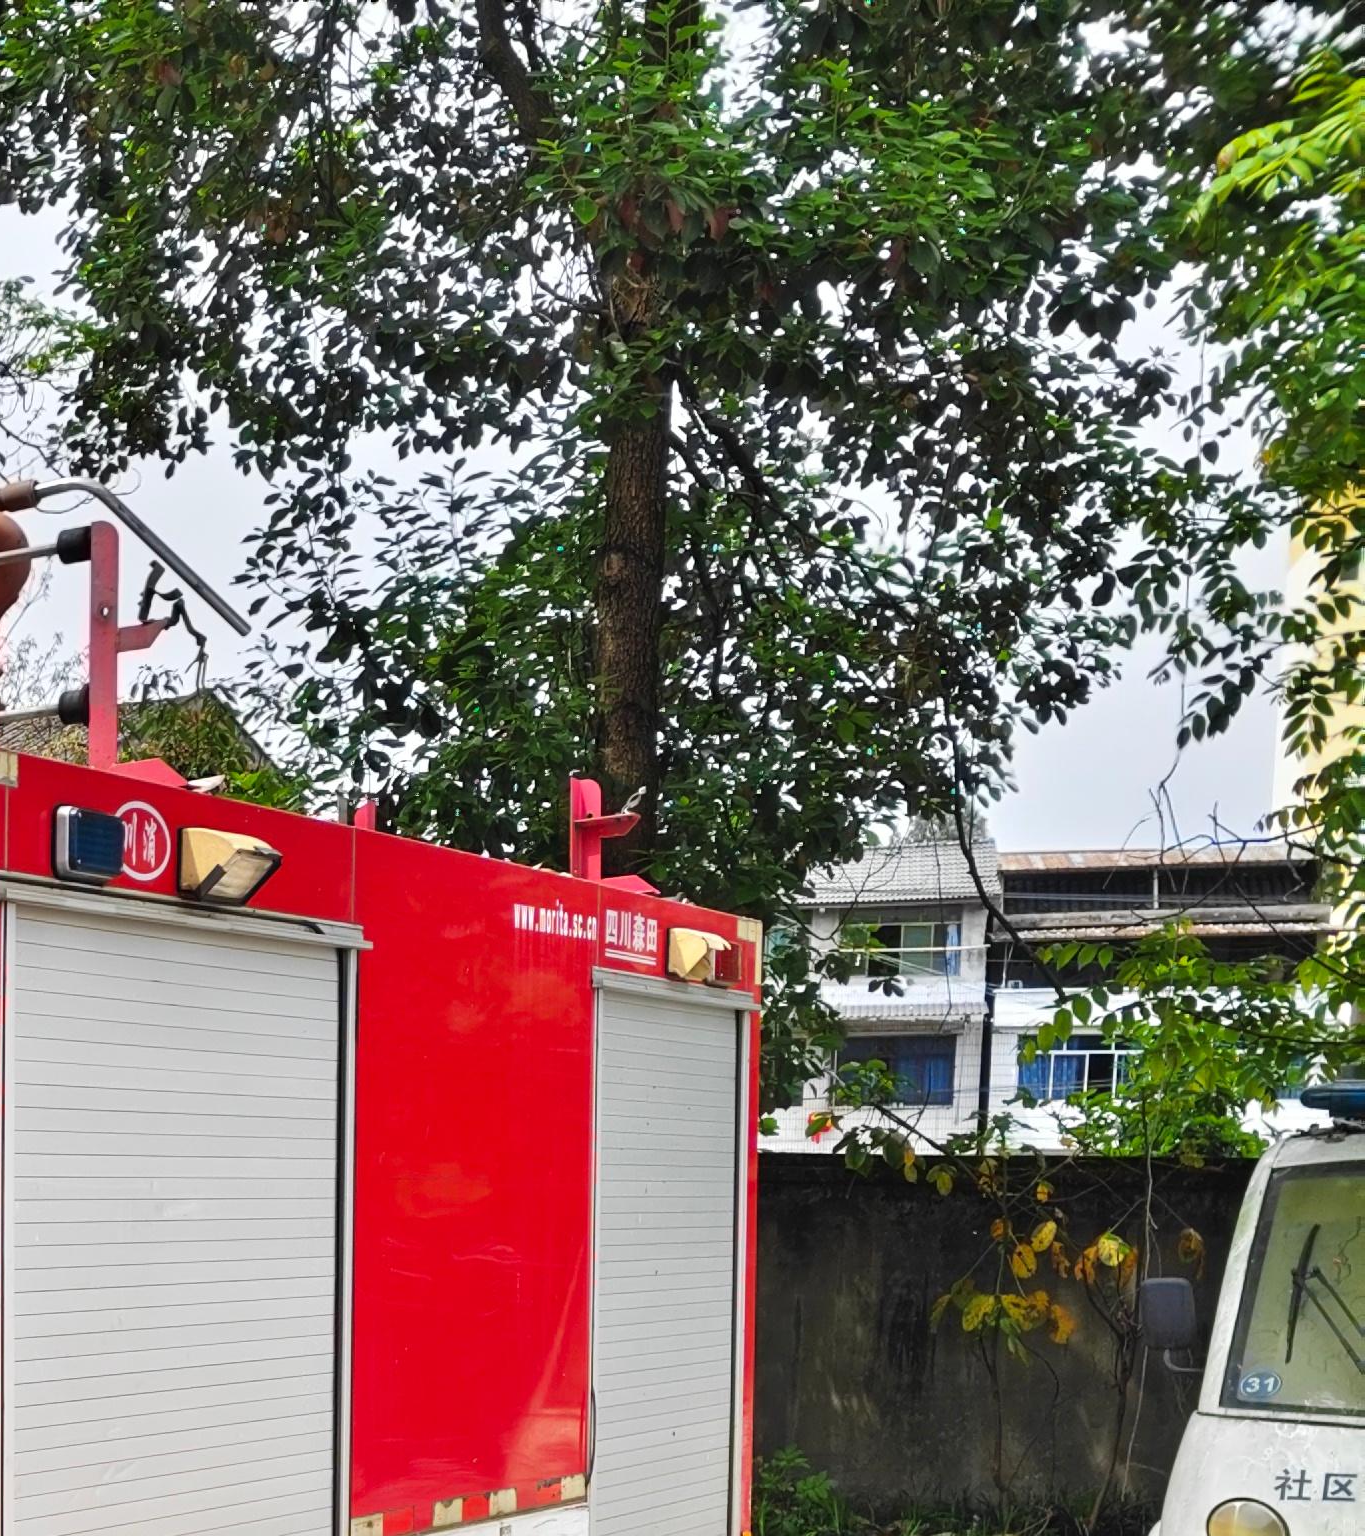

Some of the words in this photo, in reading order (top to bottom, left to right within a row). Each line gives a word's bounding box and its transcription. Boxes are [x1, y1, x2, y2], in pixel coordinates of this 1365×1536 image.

[513, 899, 597, 941] www.morita.sc.cn
[605, 909, 658, 952] 四川森田
[1246, 1376, 1277, 1394] 31
[1274, 1469, 1358, 1502] 社区
